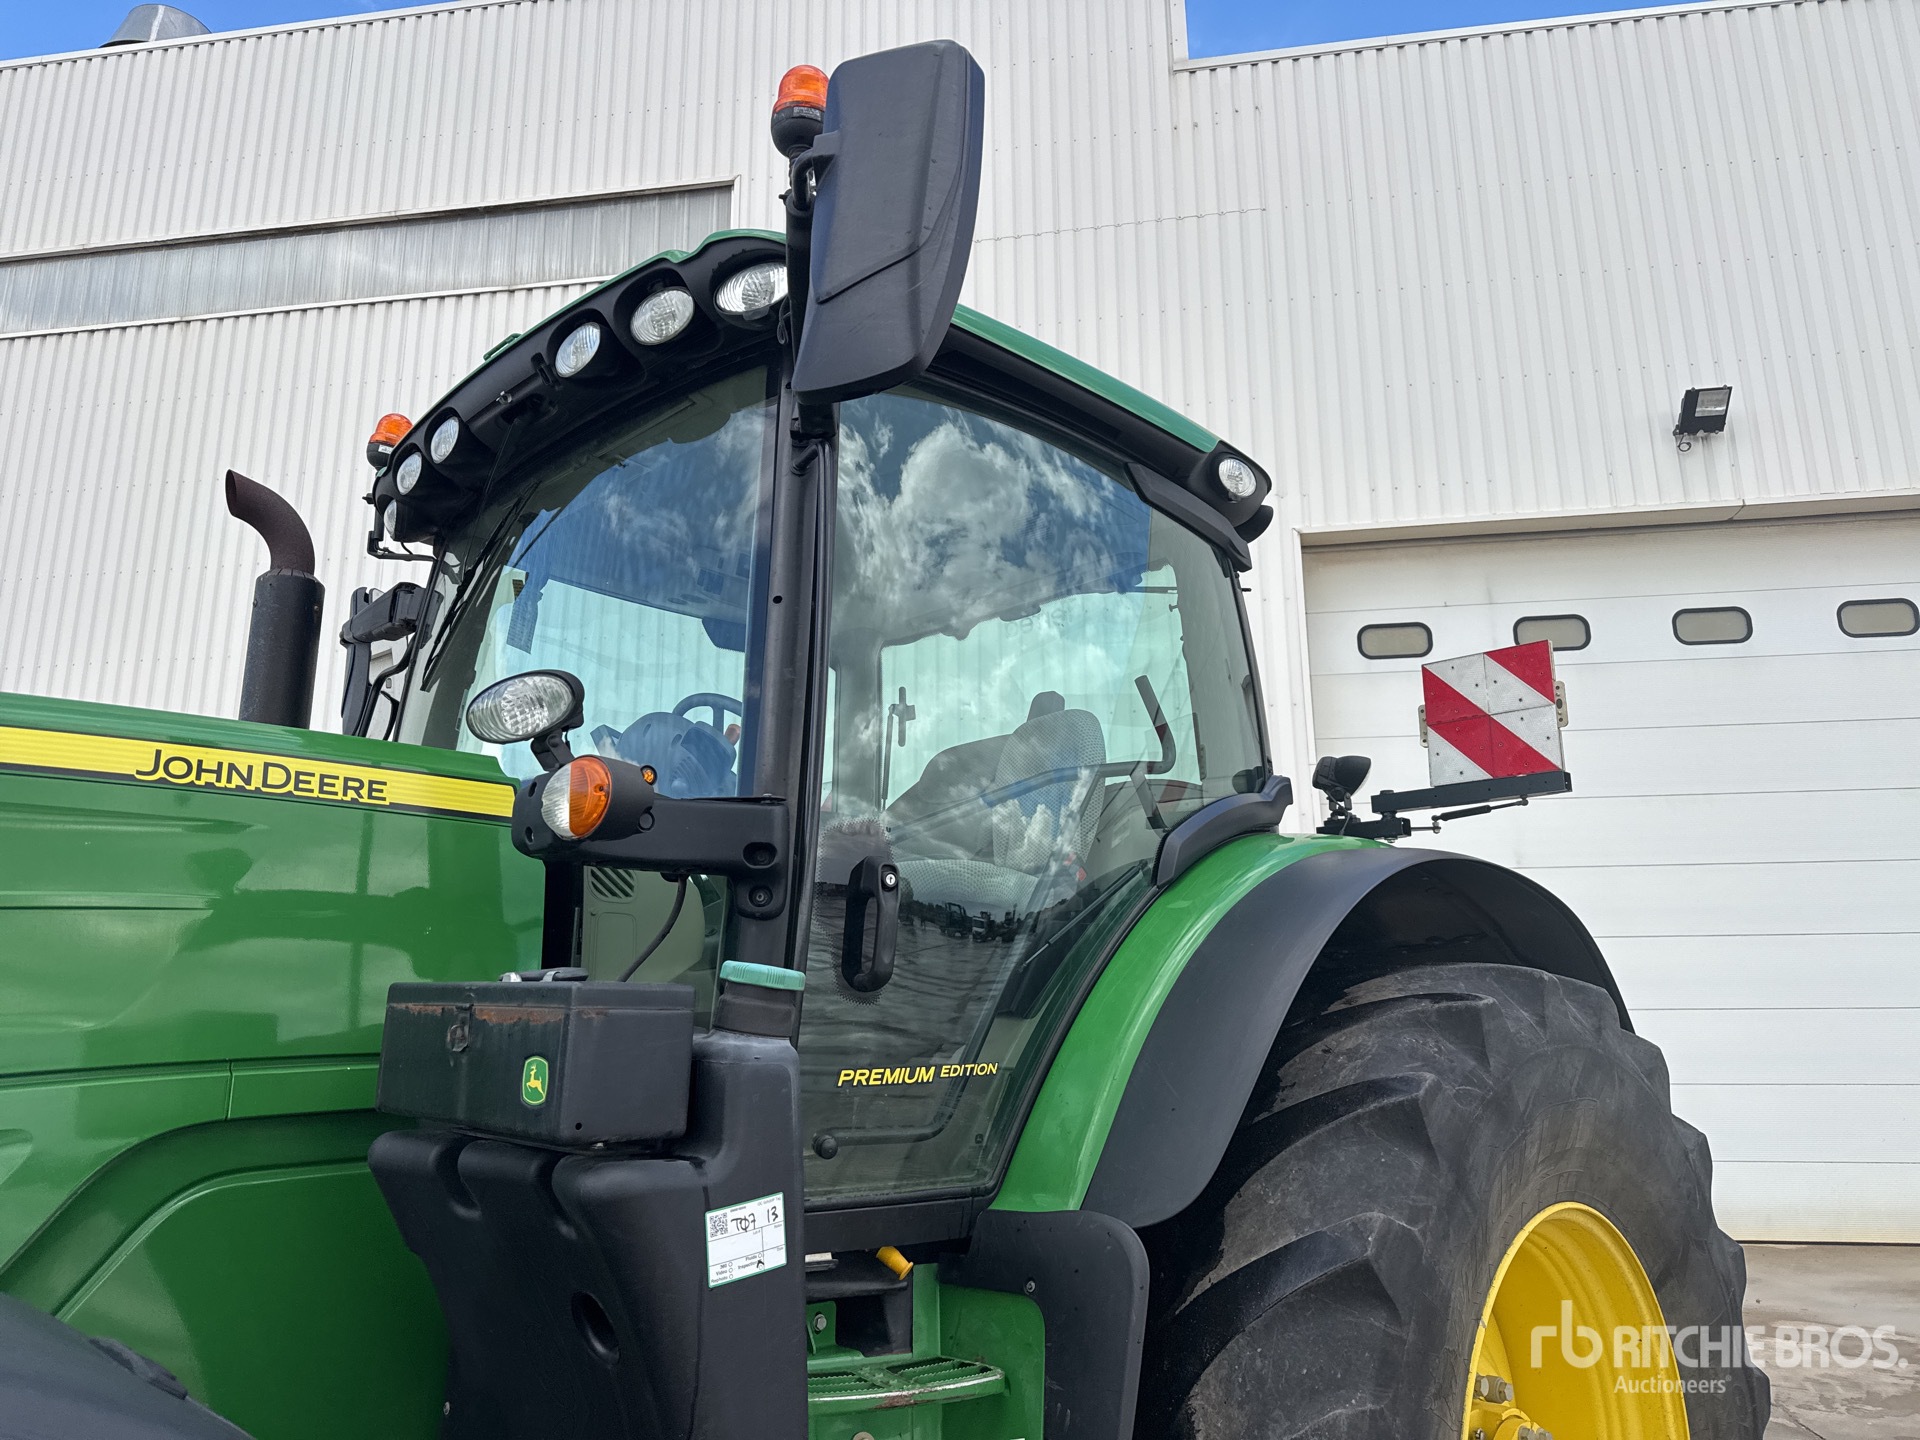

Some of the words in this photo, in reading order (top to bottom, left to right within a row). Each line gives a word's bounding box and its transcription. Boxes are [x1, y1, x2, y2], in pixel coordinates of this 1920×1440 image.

[837, 1066, 936, 1087] PREMIUM
[939, 1062, 999, 1078] EDITION
[766, 1205, 779, 1223] 13
